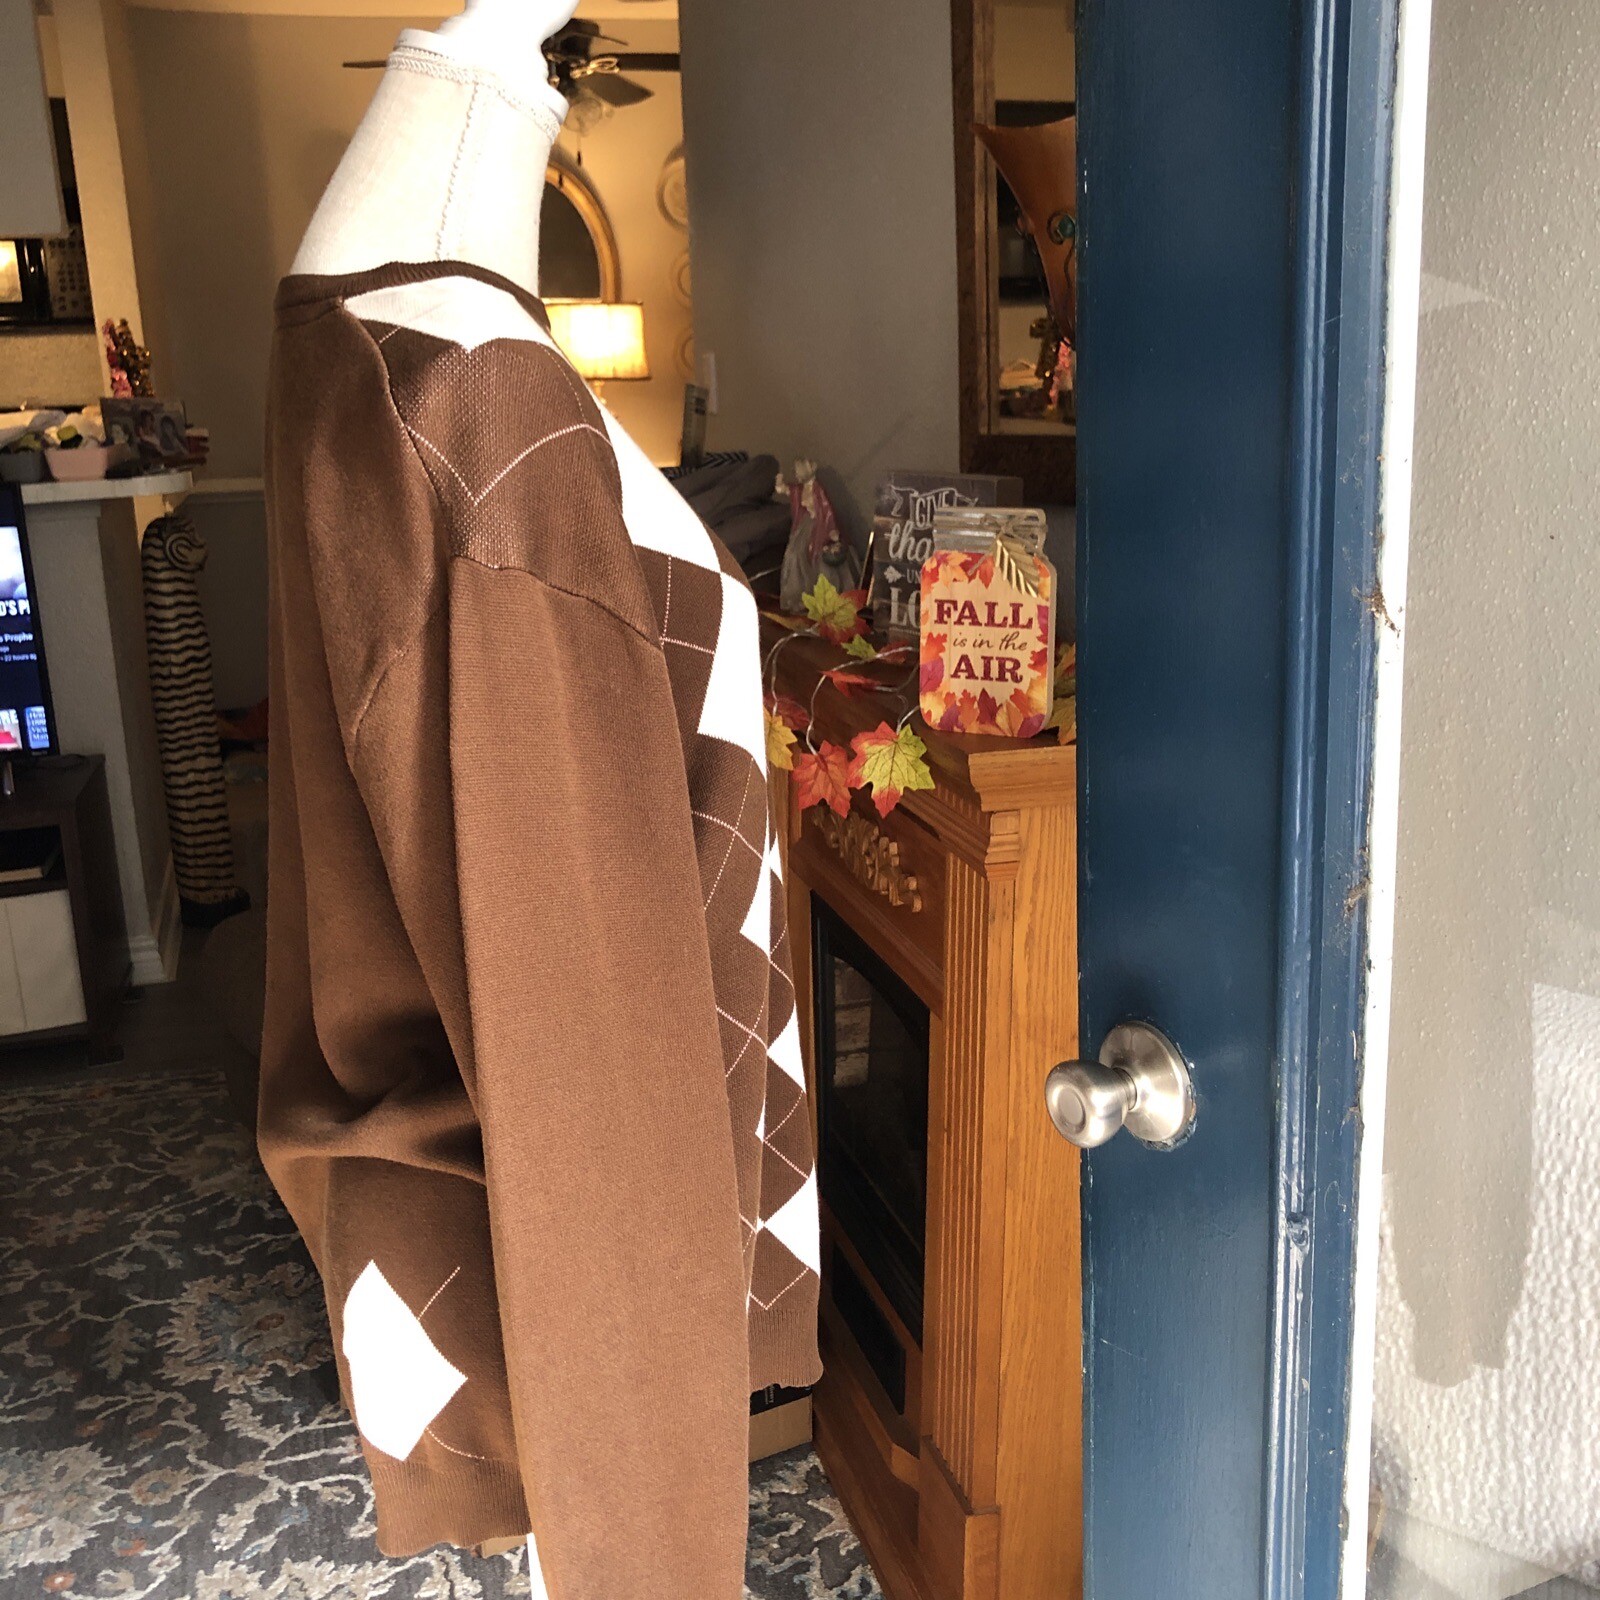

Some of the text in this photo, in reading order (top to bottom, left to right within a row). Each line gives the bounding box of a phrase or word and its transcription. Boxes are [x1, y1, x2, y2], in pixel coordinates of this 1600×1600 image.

[933, 598, 1034, 630] FALL
[953, 631, 1028, 651] is in the
[950, 654, 1024, 684] AIR
